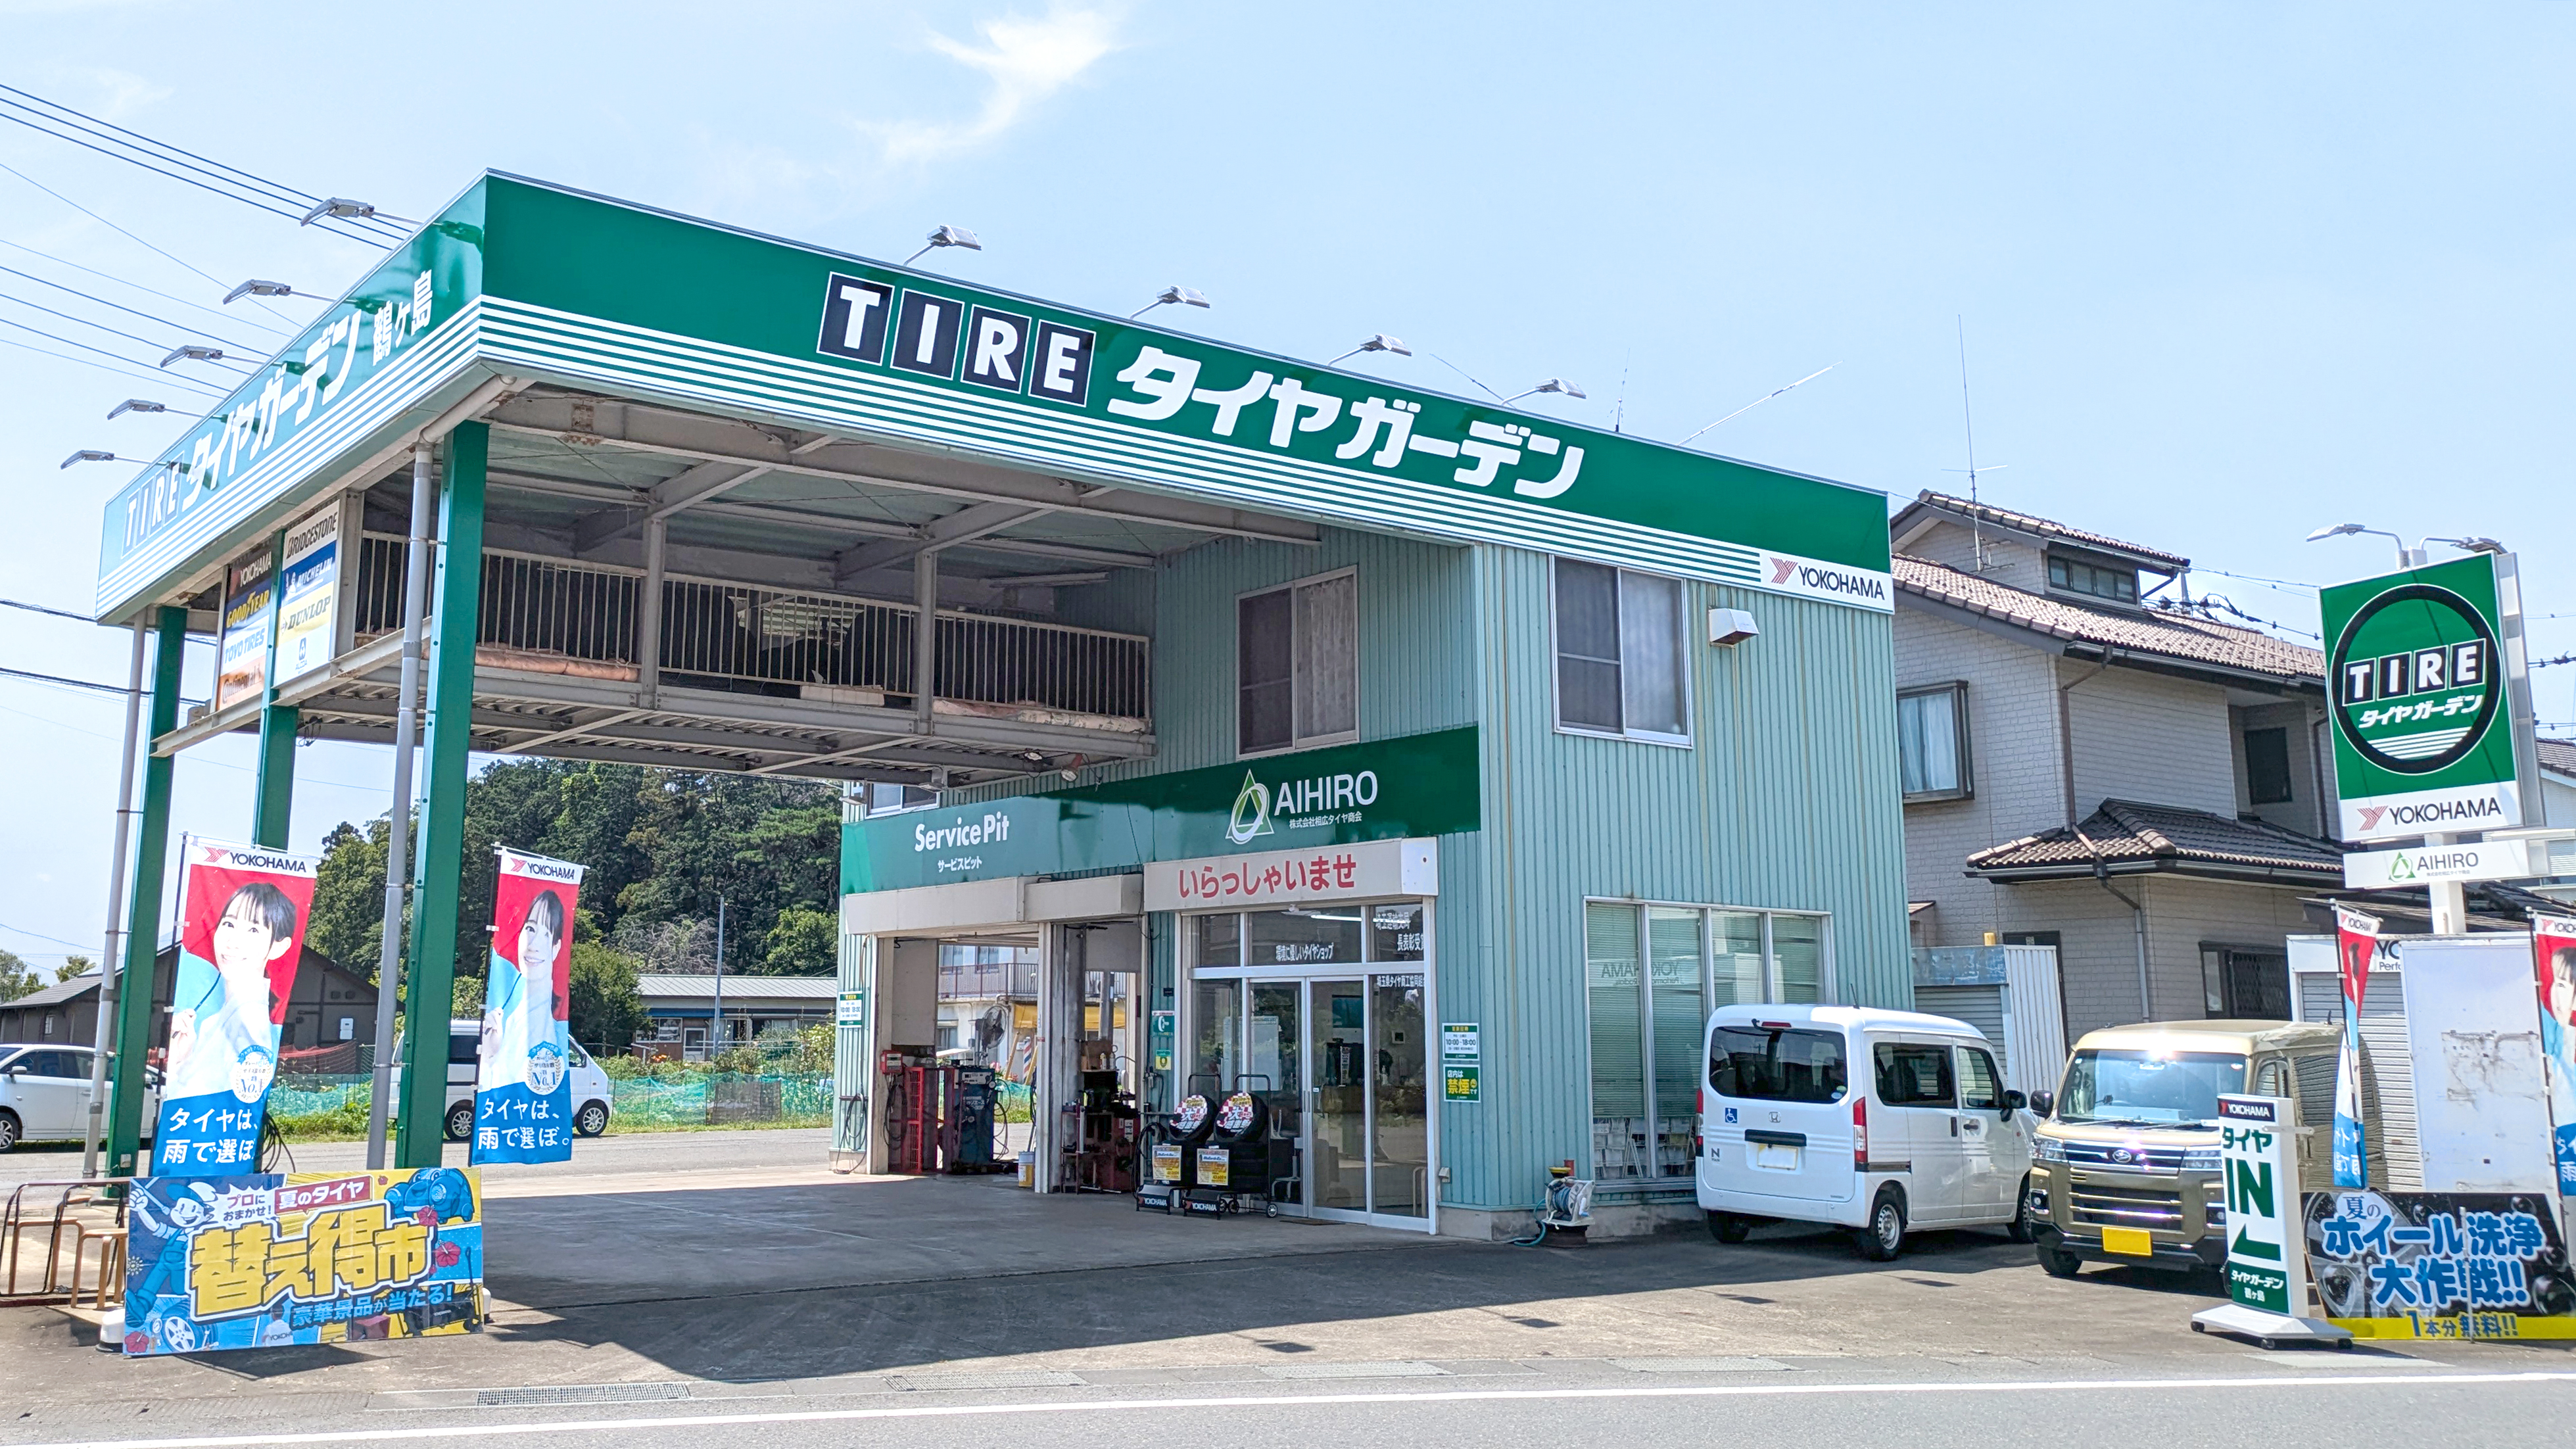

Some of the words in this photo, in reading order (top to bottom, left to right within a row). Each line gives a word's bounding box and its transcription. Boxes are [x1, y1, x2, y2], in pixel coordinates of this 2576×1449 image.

[840, 285, 1081, 394] TIRE
[1107, 345, 1585, 499] タイヤガーデン
[127, 462, 181, 547] TIRE
[181, 309, 362, 512] タイヤガーデン
[286, 511, 338, 559] BRIDGESTONE
[240, 551, 272, 587] YOKOHAMA
[297, 558, 333, 588] MICHELIN
[1798, 565, 1885, 600] YOKOHAMA
[287, 595, 331, 630] DUNLOP
[224, 640, 244, 664] TOYO
[244, 628, 266, 651] TIRES
[2349, 641, 2477, 699] TIRE
[222, 667, 256, 703] Continental
[2358, 694, 2483, 728] タイヤガーデン
[1274, 771, 1378, 816] AIHIRO
[2389, 797, 2502, 825] YOKOHAMA
[915, 817, 982, 851] Service
[984, 811, 1009, 843] Pit
[231, 852, 306, 872] YOKOHAMA
[527, 861, 575, 880] YOKOHAMA
[938, 856, 982, 873] サービスピット
[2417, 852, 2479, 870] AIHIRO
[1179, 853, 1357, 899] いらっしゃいませ
[1447, 1070, 1464, 1078] 店内は
[1448, 1078, 1470, 1095] 禁煙
[169, 1108, 258, 1133] タイヤは、
[481, 1098, 560, 1120] タイヤは、
[2228, 1103, 2271, 1117] YOKOHAMA
[478, 1126, 569, 1150] 雨で選ぼ。
[2222, 1126, 2272, 1153] タイヤ
[1711, 1147, 1720, 1158] N
[226, 1193, 266, 1208] プロに
[278, 1181, 365, 1207] 夏のタイヤ
[2225, 1157, 2275, 1218] IN
[1192, 1202, 1217, 1211] YOKOHAMA
[2346, 1195, 2381, 1219] 夏の
[2324, 1214, 2543, 1256] ホイール洗浄
[191, 1206, 431, 1316] 替え得市
[2231, 1270, 2284, 1289] タイヤガーデン
